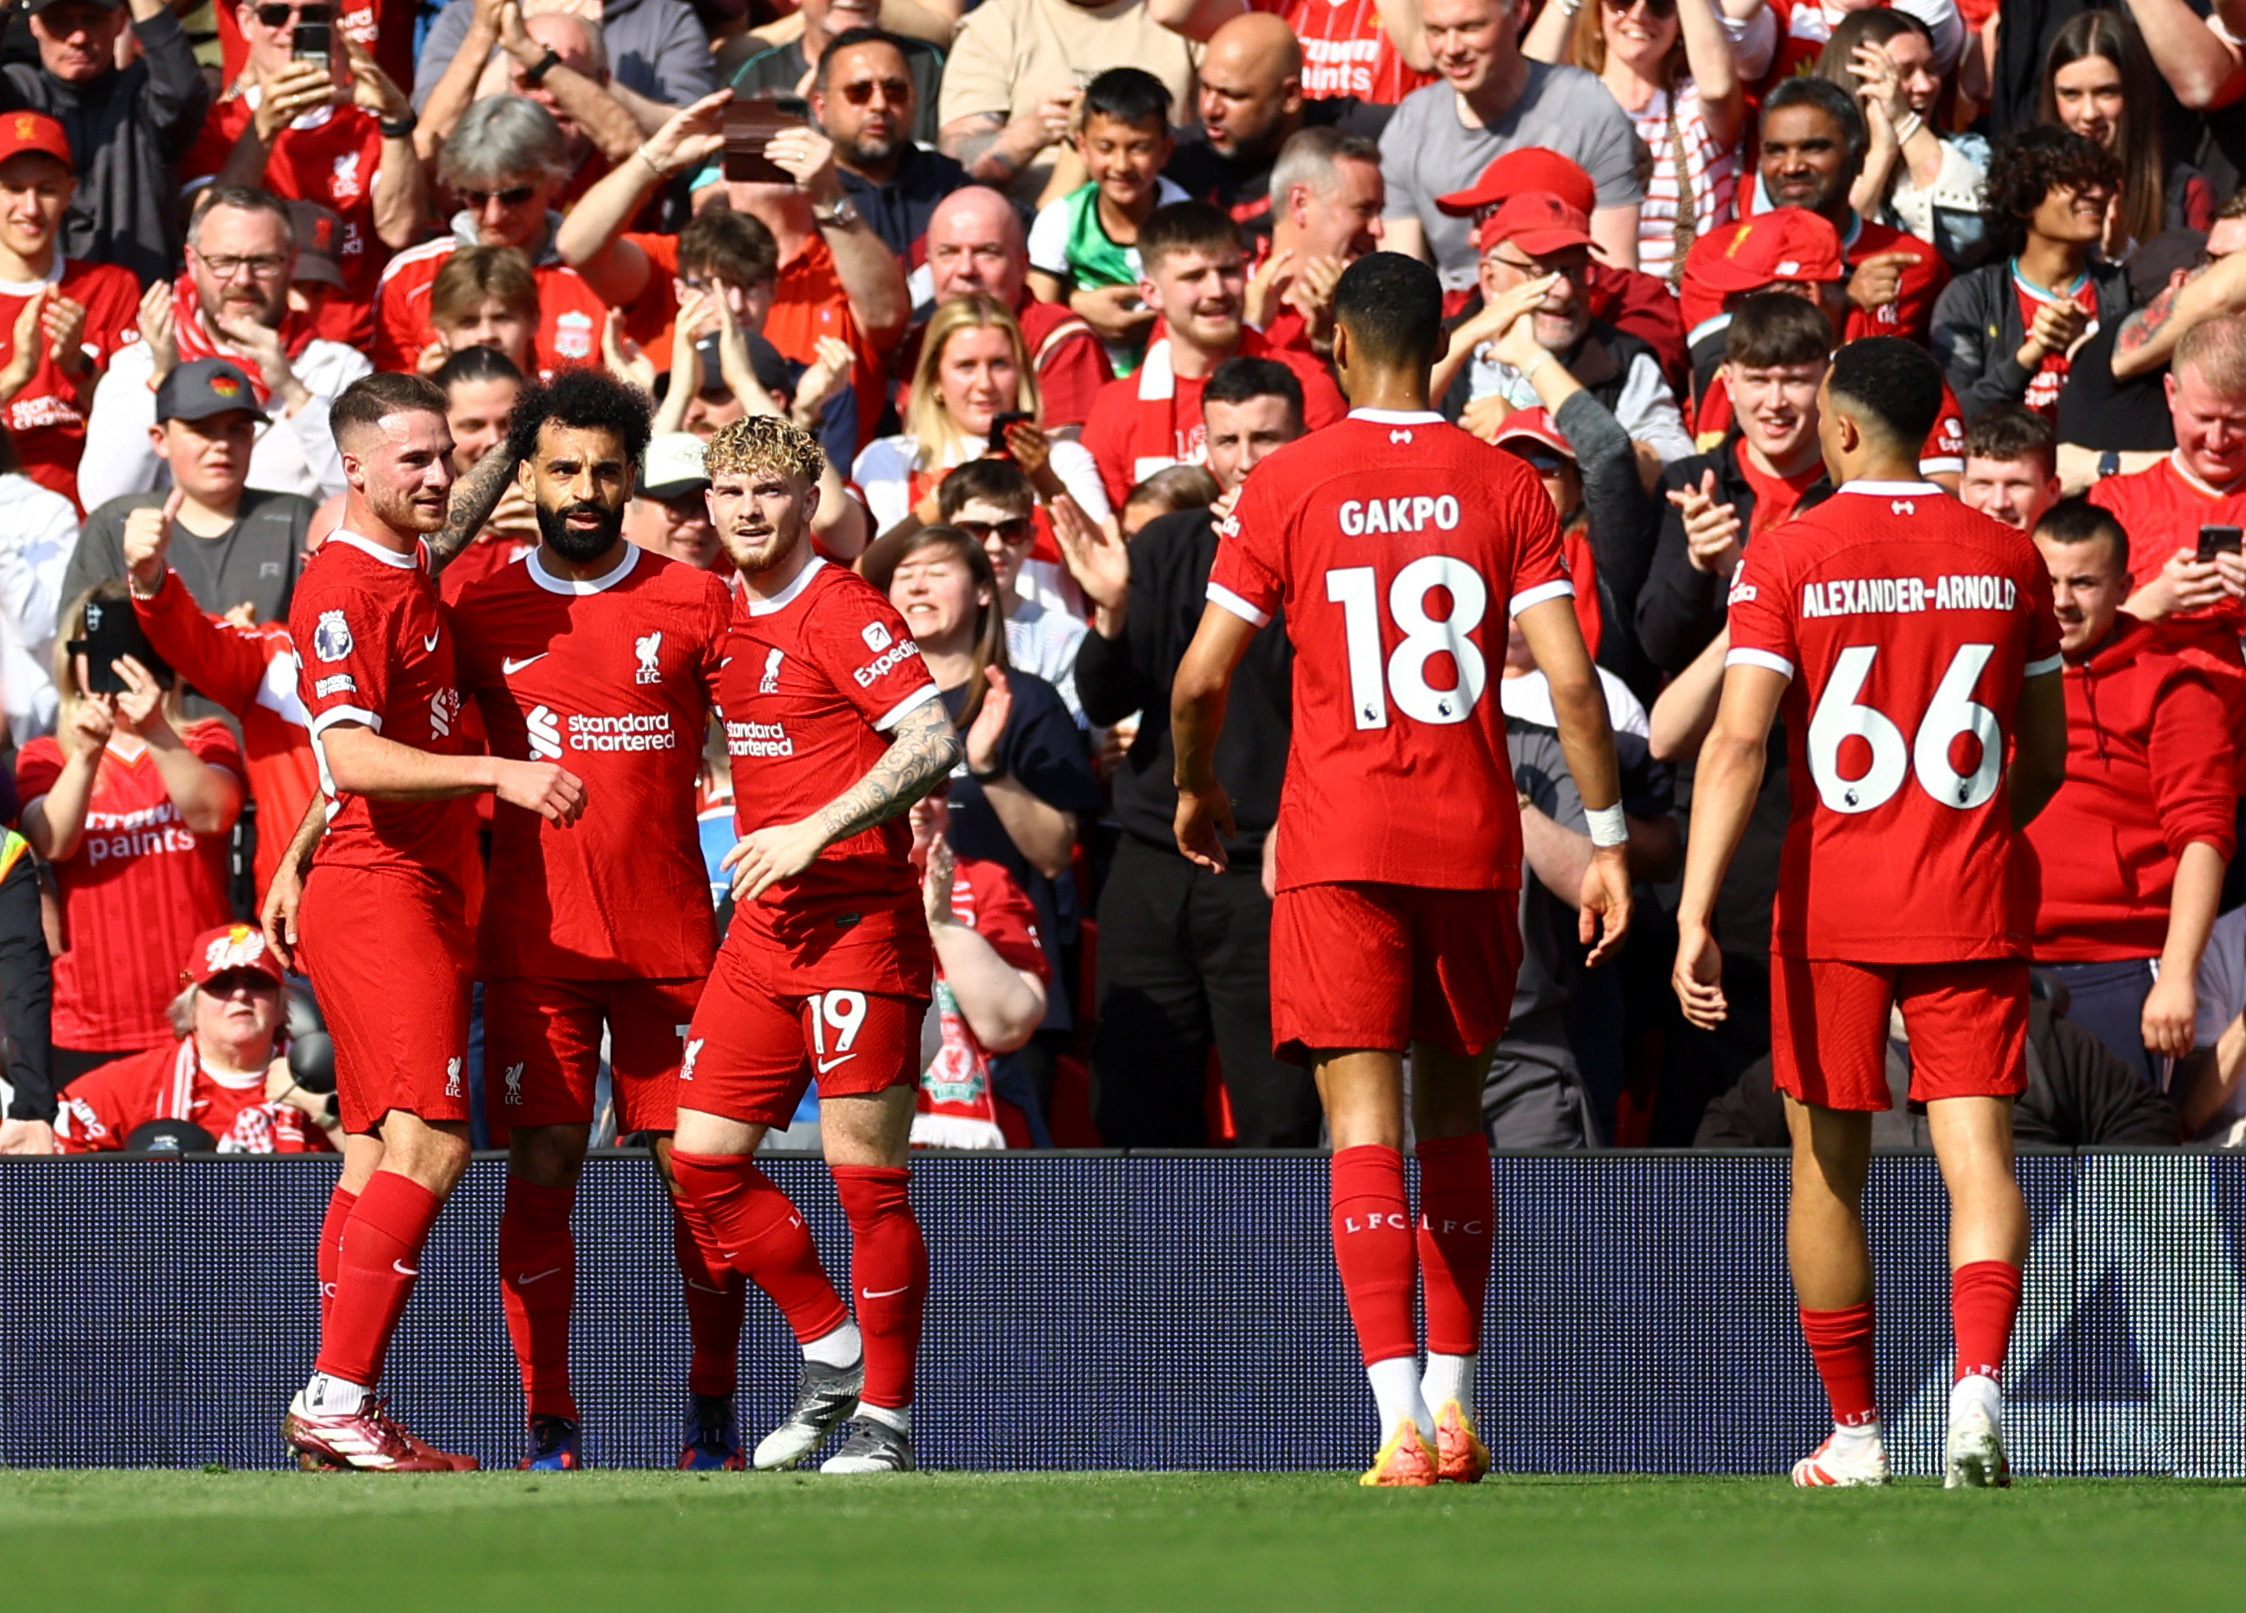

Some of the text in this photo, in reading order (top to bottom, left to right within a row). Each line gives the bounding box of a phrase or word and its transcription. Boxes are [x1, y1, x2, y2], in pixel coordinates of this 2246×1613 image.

[1339, 495, 1460, 536] GAKPO
[1803, 576, 2016, 618] ALEXANDER-ARNOLD
[853, 638, 919, 688] Expedia
[1325, 555, 1487, 731] 18
[567, 712, 669, 733] standard
[569, 730, 675, 751] chartered
[1807, 643, 2002, 814] 66
[88, 826, 196, 867] paints
[806, 989, 867, 1055] 19
